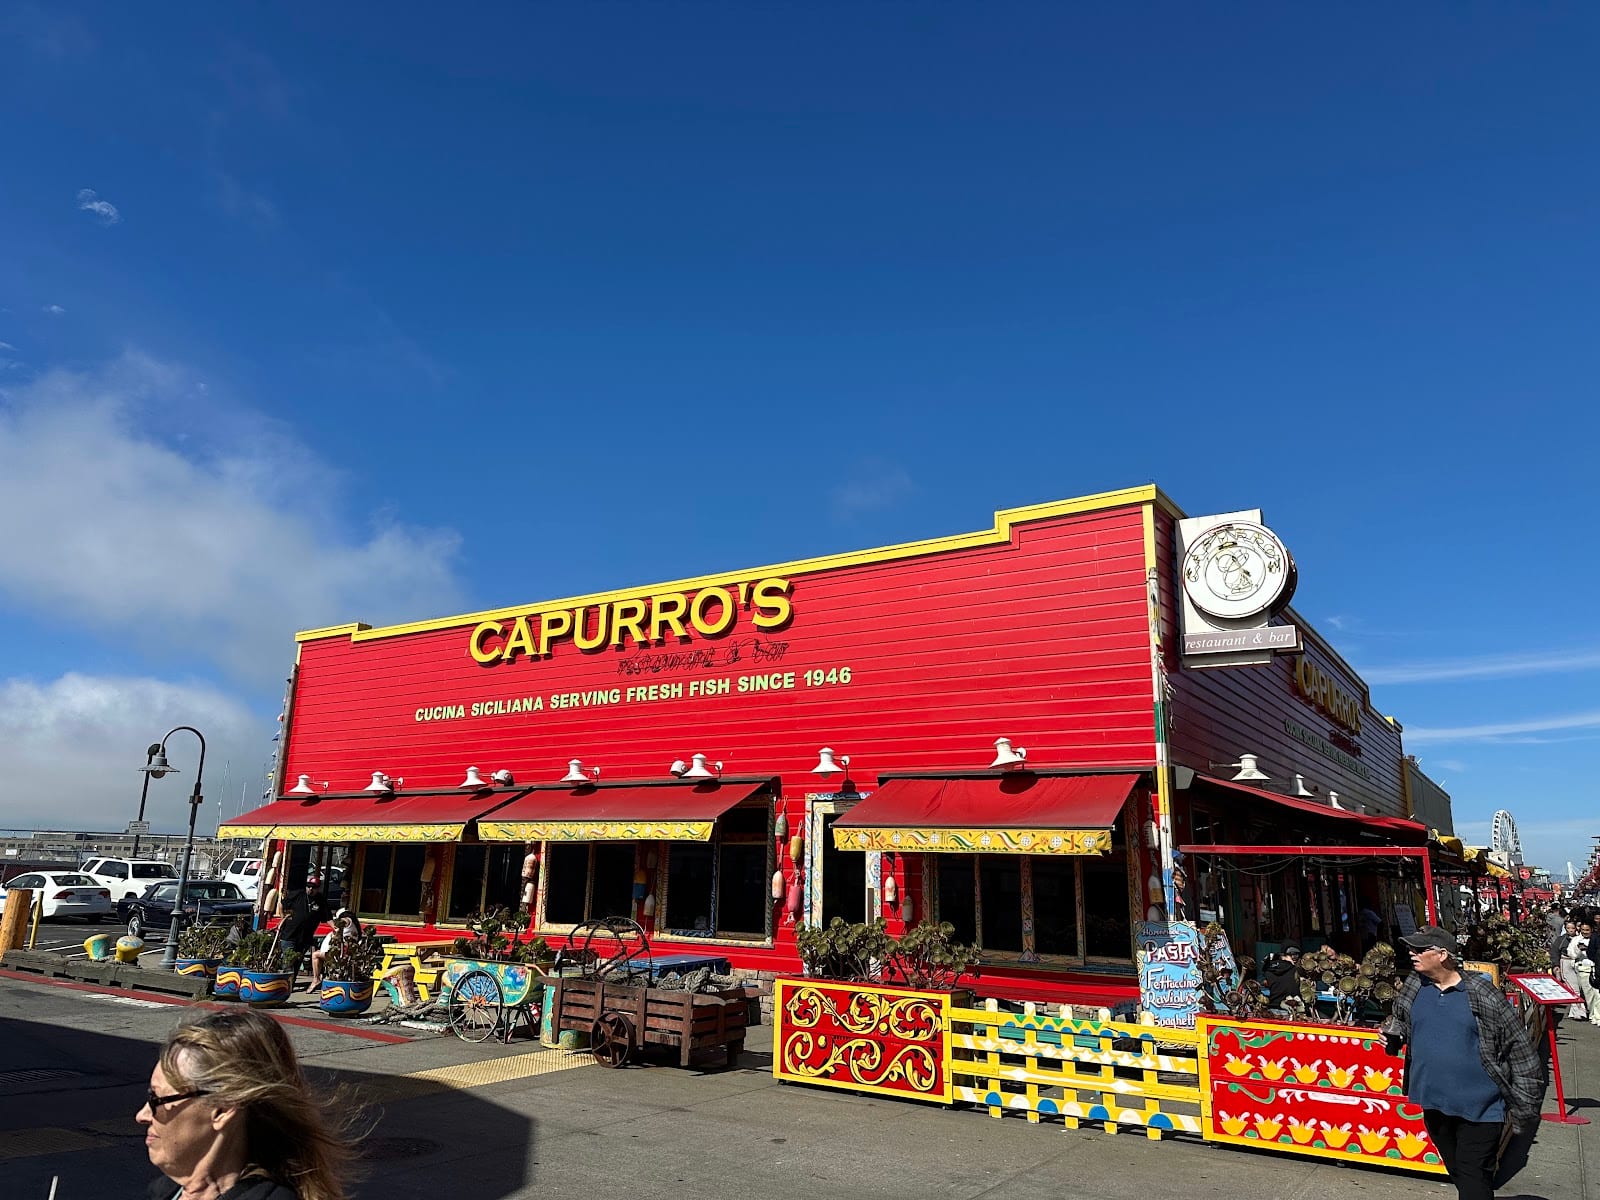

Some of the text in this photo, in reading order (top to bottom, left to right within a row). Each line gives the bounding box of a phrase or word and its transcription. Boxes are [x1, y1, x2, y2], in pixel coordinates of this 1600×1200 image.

[469, 577, 793, 664] CAPURRO'S
[1185, 631, 1291, 649] restaurant & bar
[414, 667, 852, 722] CUCINA SICILIANA SERVING FRESH FISH SINCE 1946
[1144, 940, 1197, 962] PASTA
